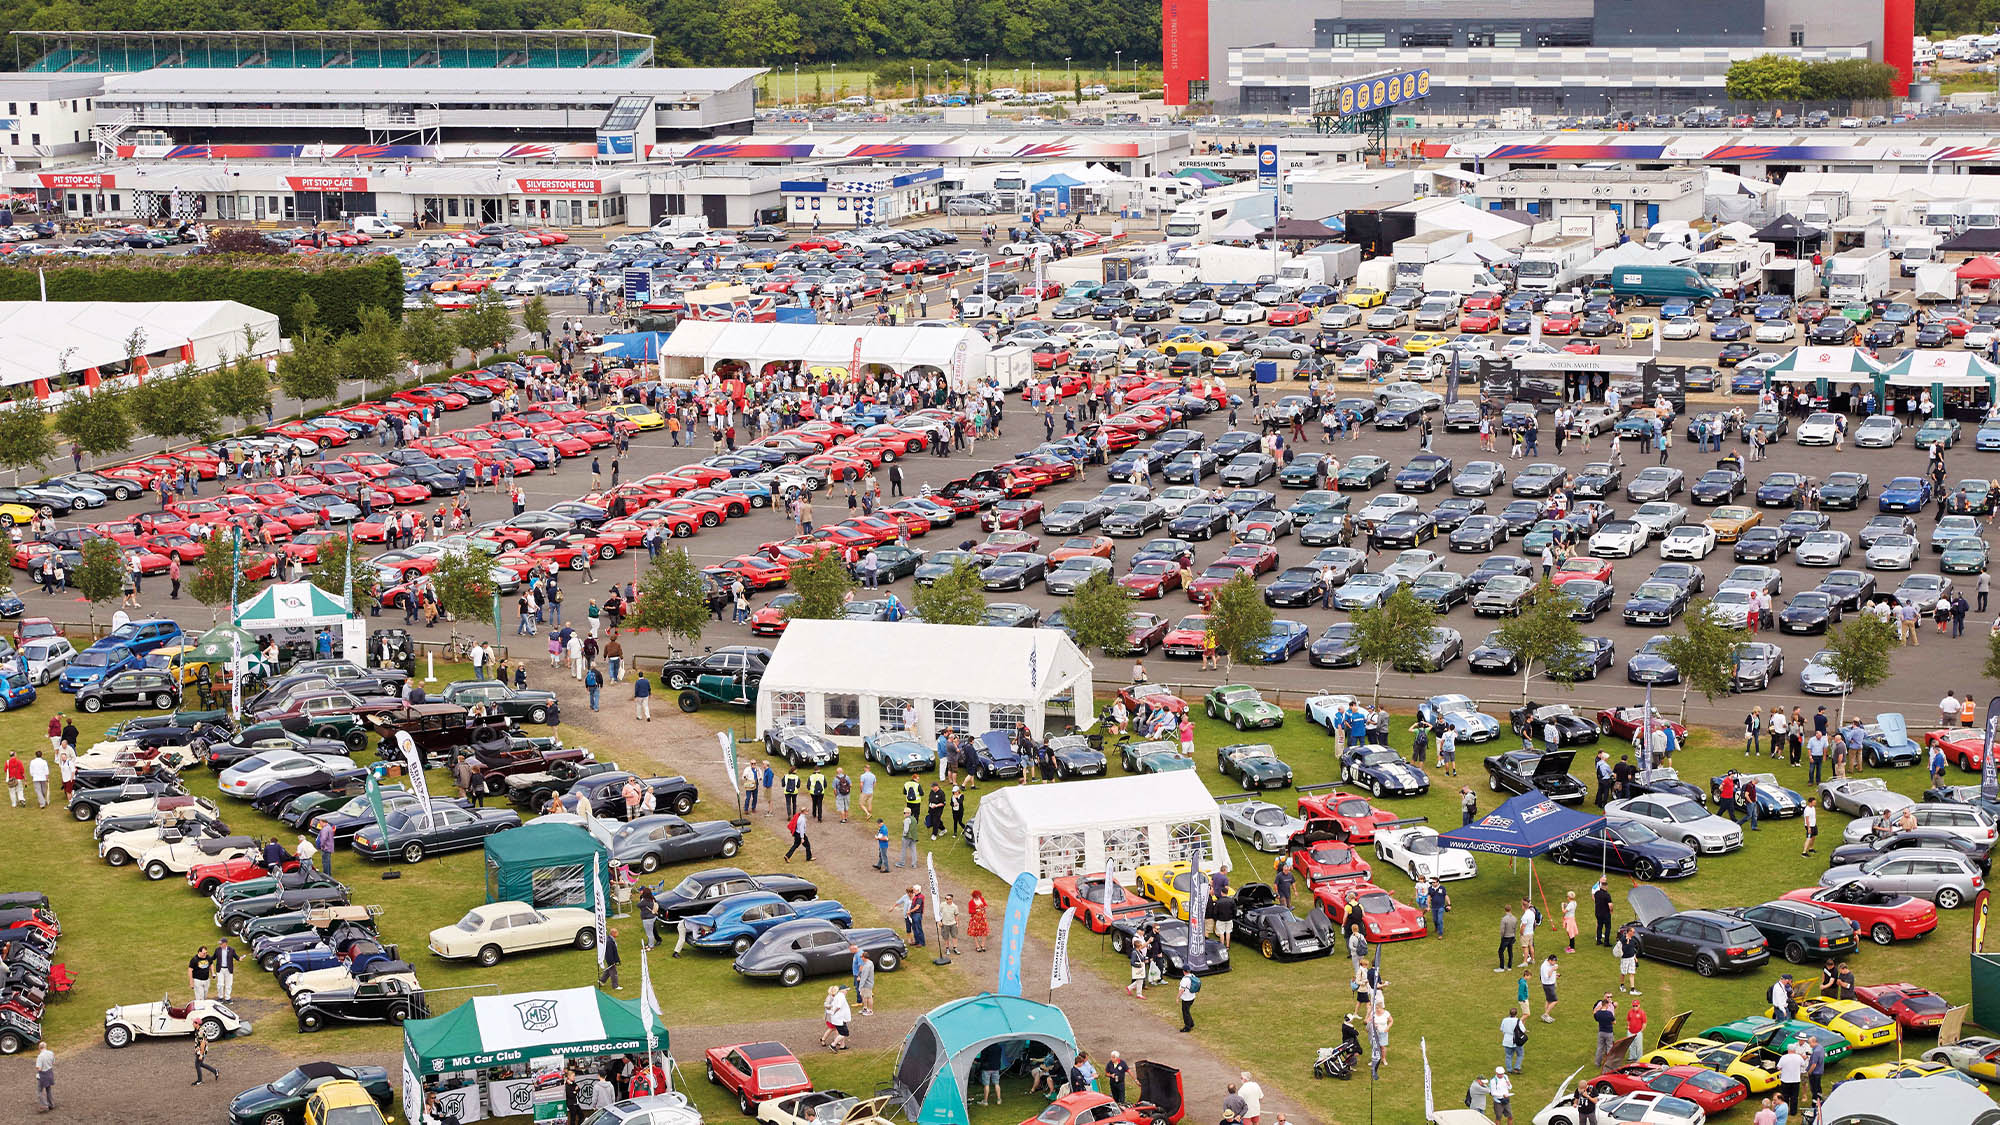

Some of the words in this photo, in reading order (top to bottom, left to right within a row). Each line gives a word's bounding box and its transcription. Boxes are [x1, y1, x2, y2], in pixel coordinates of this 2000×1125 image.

[1375, 87, 1383, 99] JET
[1343, 94, 1351, 106] JET
[53, 176, 64, 184] PIT
[64, 176, 82, 184] STOP
[302, 178, 313, 187] PIT
[314, 178, 333, 187] STOP
[526, 180, 576, 188] SILVERSTONE
[1549, 361, 1572, 369] ASTON
[1548, 828, 1591, 850] www.AudiSRS.com
[1450, 840, 1518, 855] www.AudiSRS.com
[529, 1008, 548, 1022] MG
[159, 1018, 166, 1030] 7
[551, 1040, 640, 1055] www.mgcc.com
[452, 1058, 471, 1067] MG
[474, 1055, 494, 1064] Car
[496, 1050, 522, 1061] Club
[514, 1089, 529, 1102] MG
[446, 1101, 460, 1115] MG
